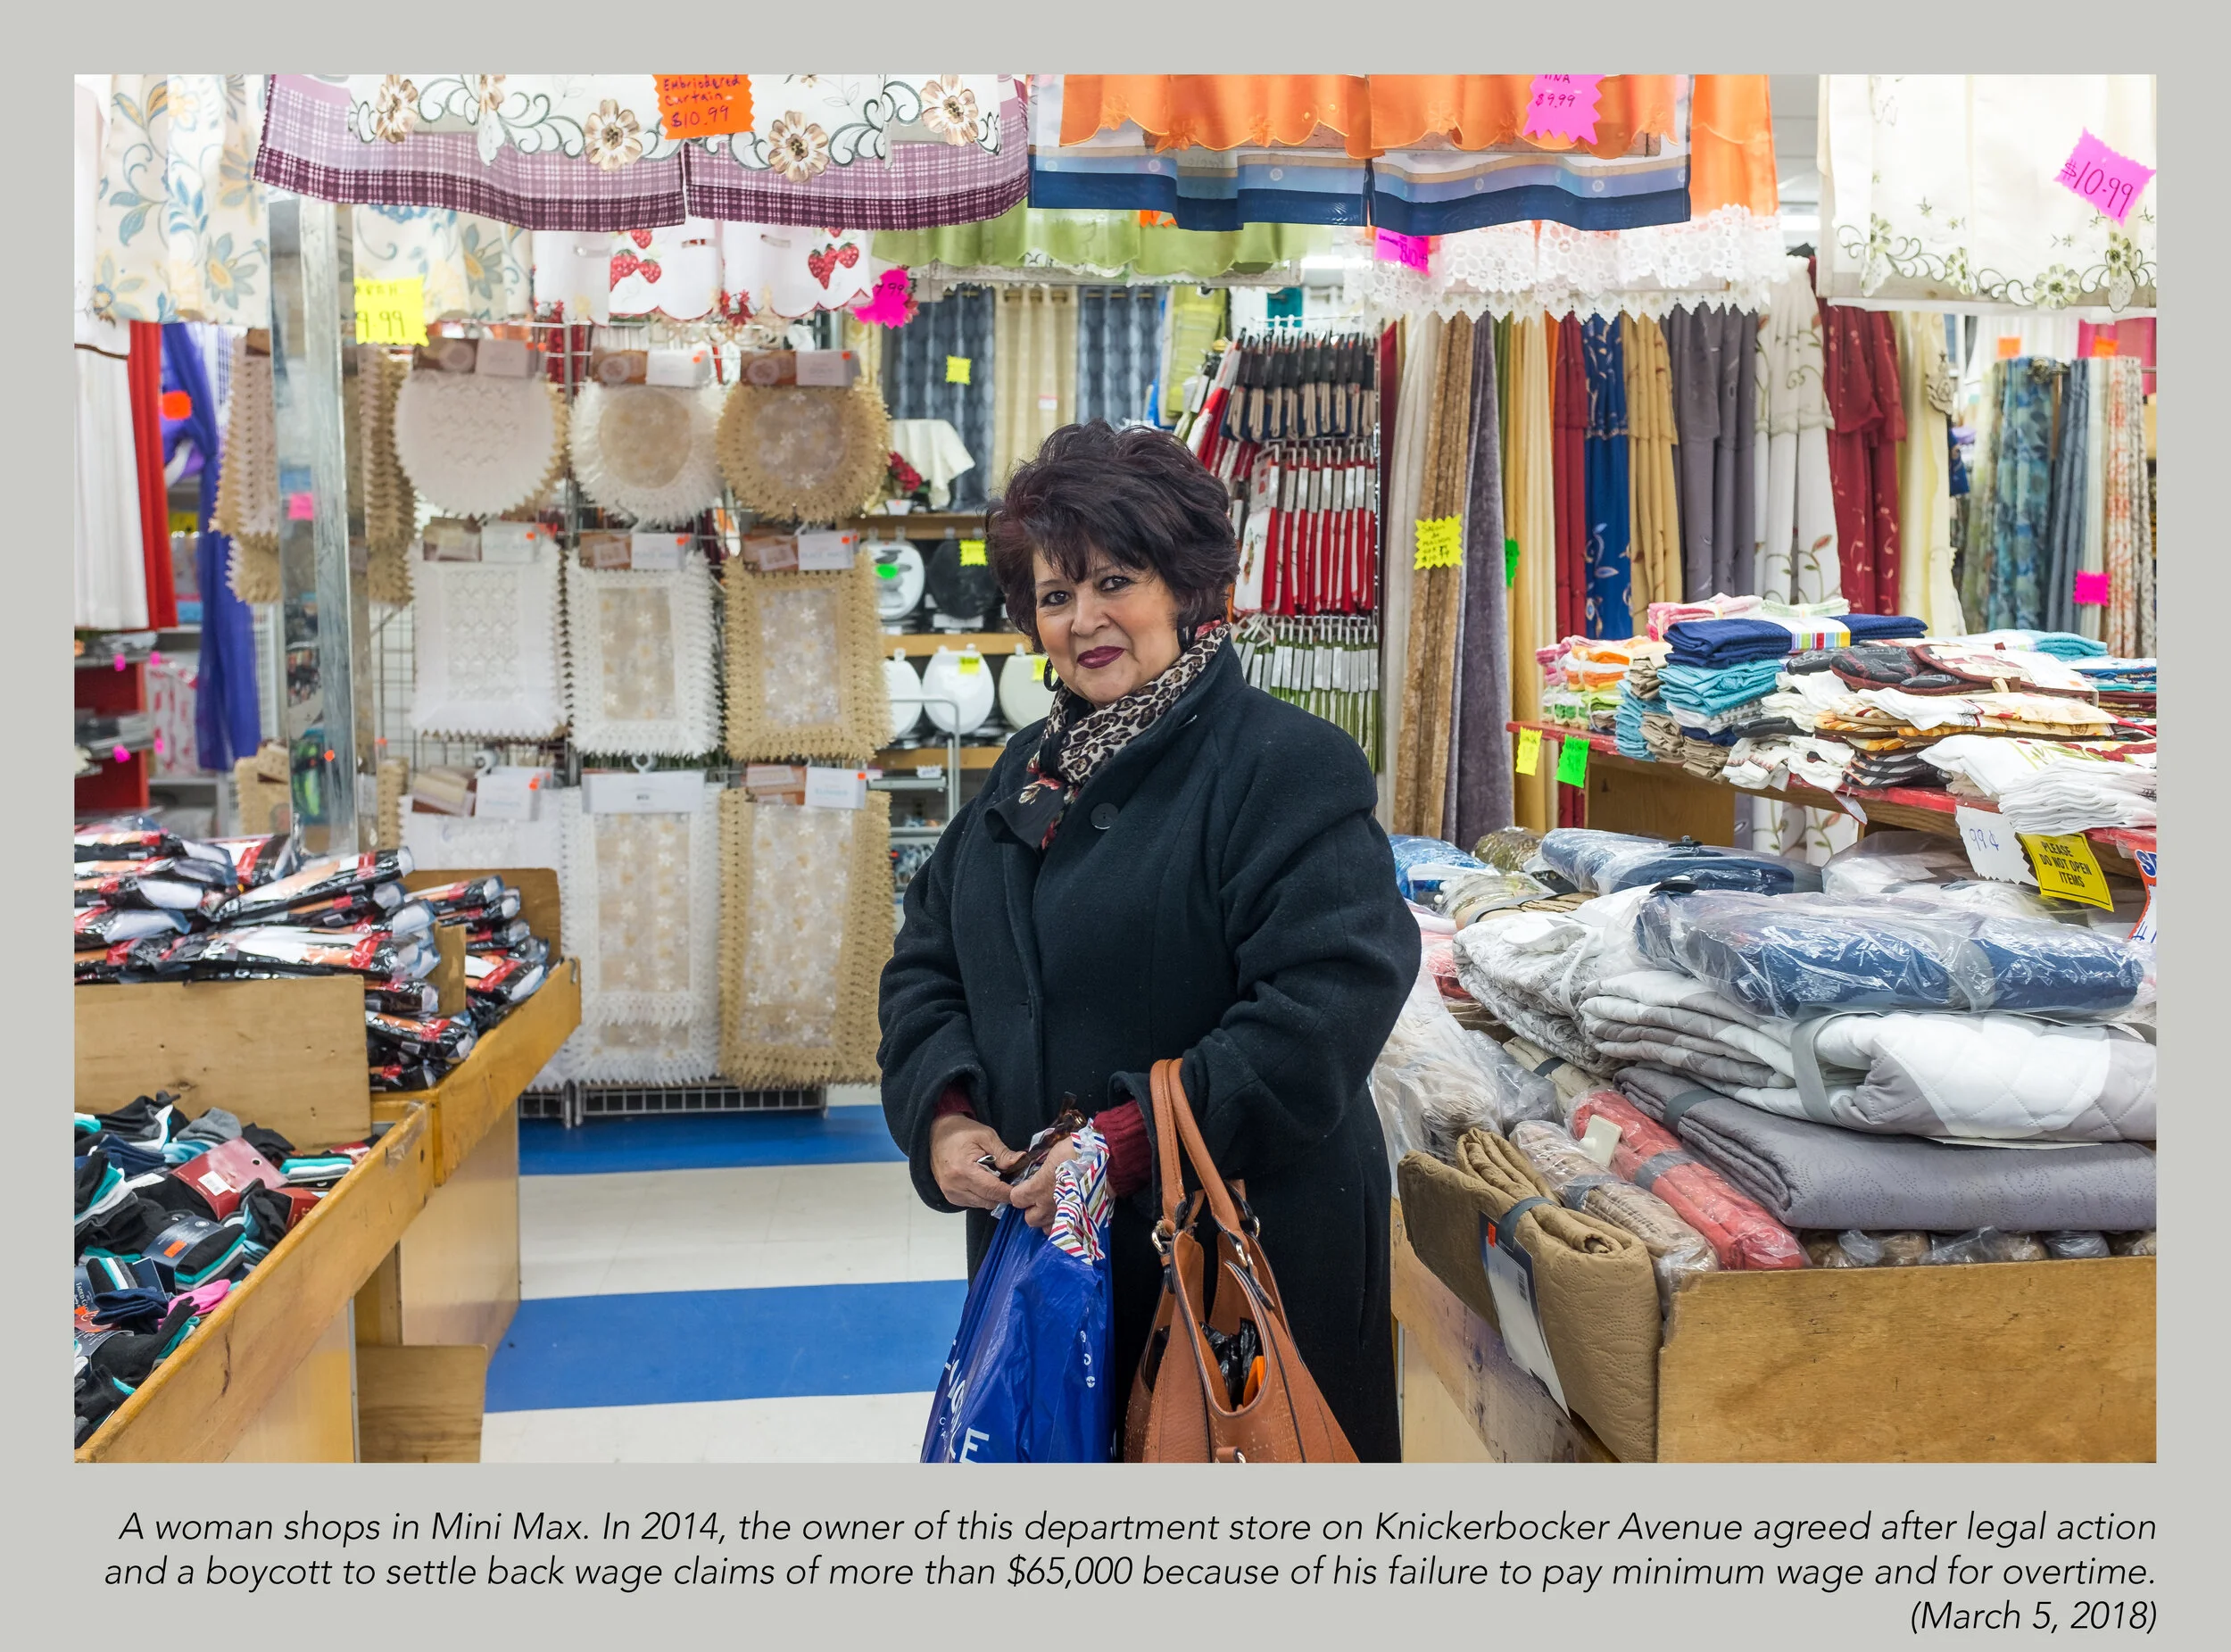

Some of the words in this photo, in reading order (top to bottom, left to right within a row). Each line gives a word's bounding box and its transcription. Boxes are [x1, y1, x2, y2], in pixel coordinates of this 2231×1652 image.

[1535, 93, 1576, 108] $9.99
[670, 105, 729, 129] $10.99
[2061, 159, 2134, 218] $10.99
[2041, 841, 2074, 858] PLEASE
[2039, 853, 2053, 867] DO
[2052, 856, 2069, 870] NOT
[2069, 859, 2093, 876] OPEN
[2058, 870, 2086, 888] ITEMS
